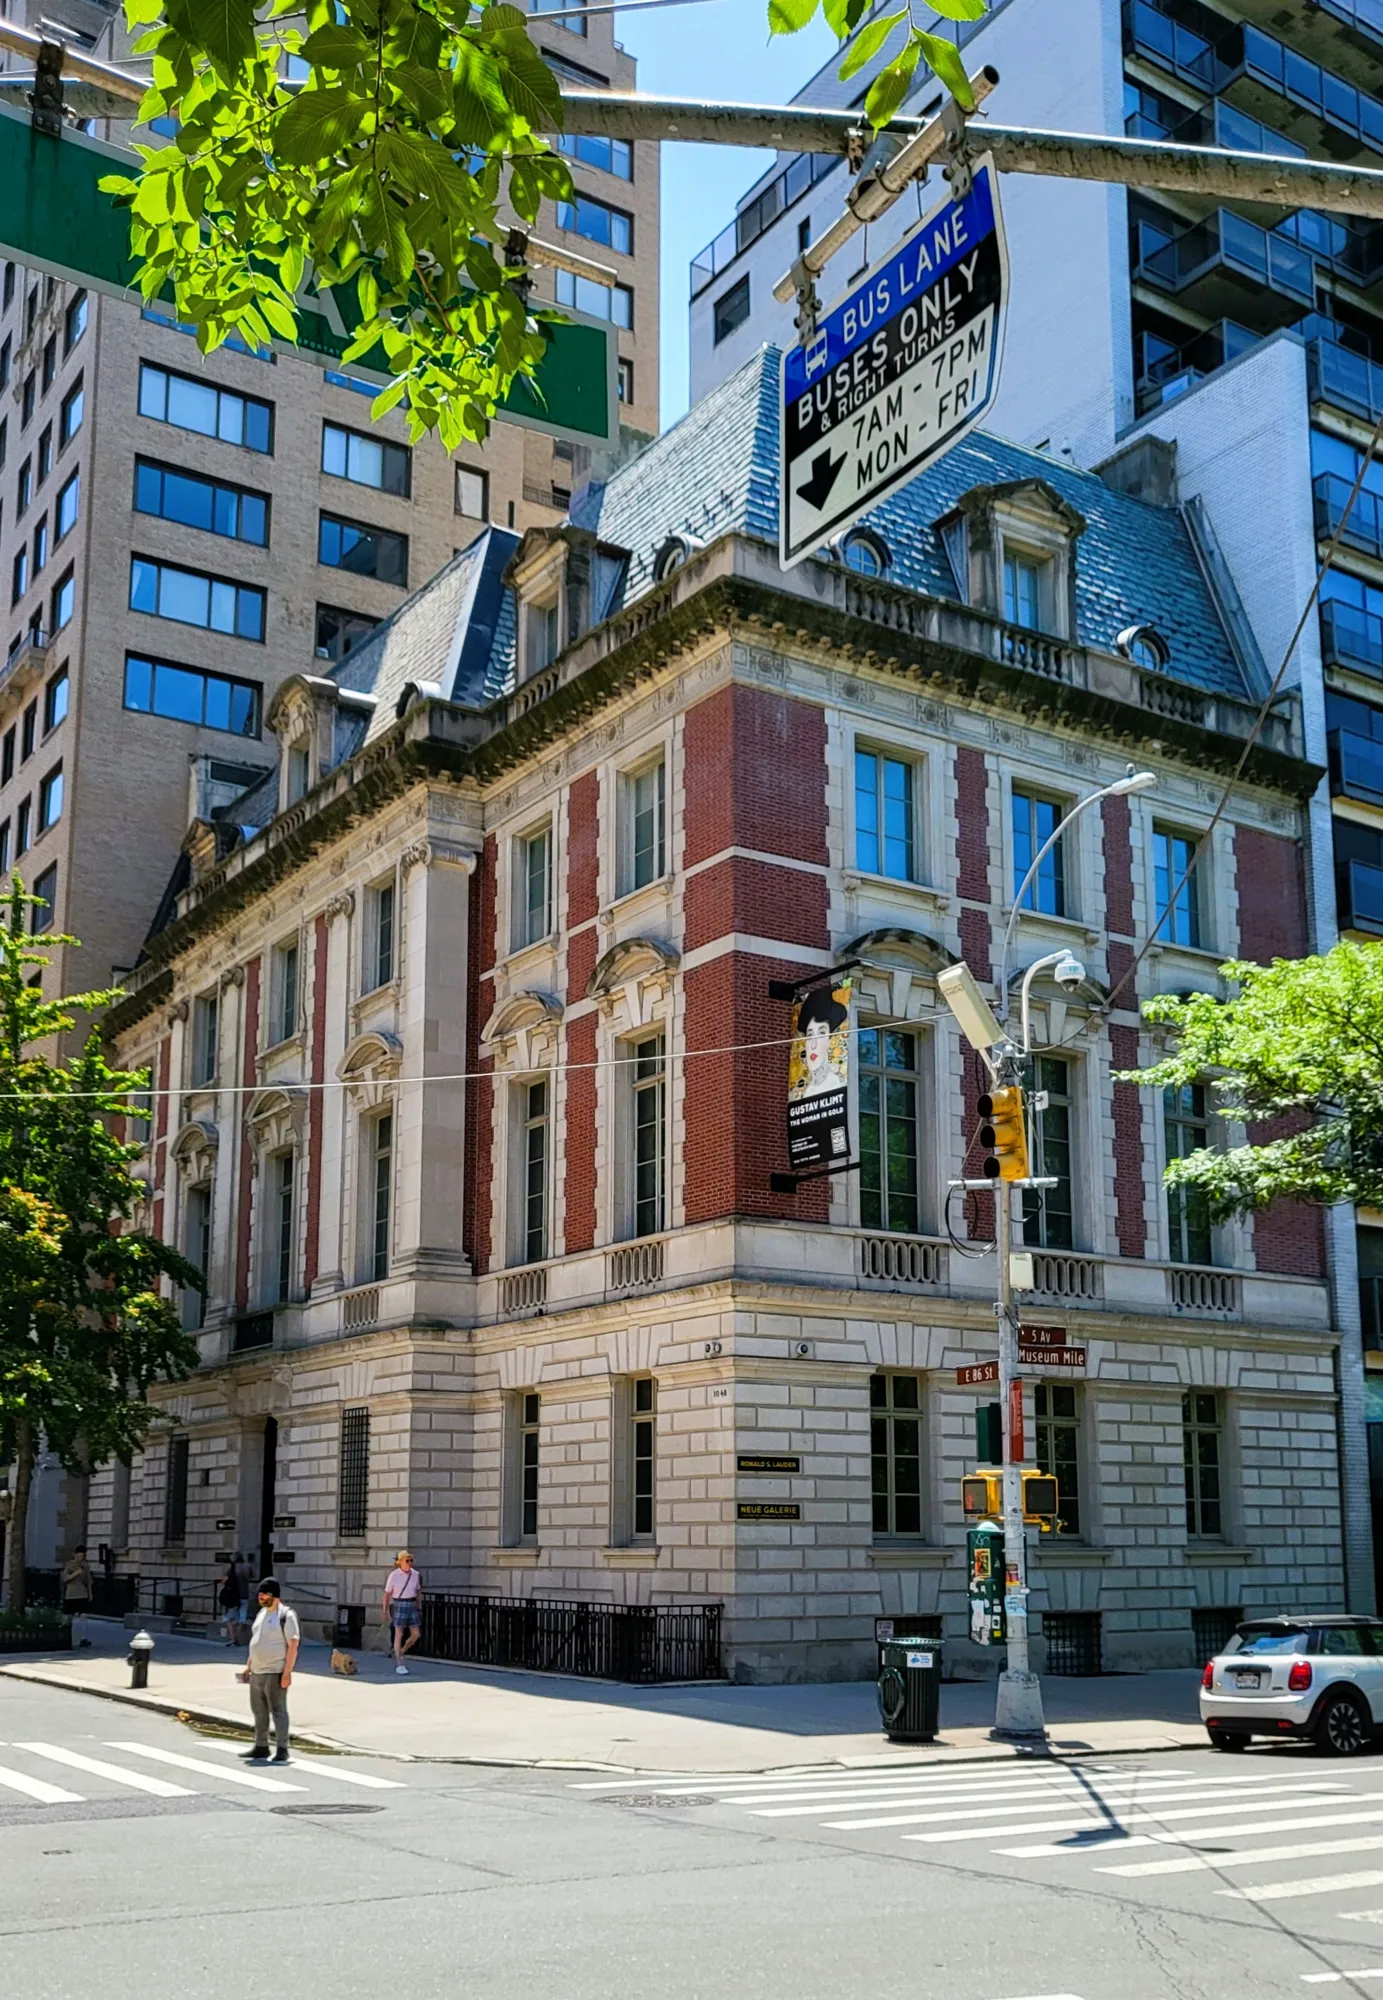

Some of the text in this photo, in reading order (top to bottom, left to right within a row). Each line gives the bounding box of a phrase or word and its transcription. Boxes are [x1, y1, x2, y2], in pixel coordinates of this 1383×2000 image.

[843, 205, 968, 344] BUS LANE
[799, 250, 979, 430] BUSES ONLY
[821, 312, 955, 432] & RIGHT TURNS
[853, 385, 902, 449] 7AM
[932, 318, 986, 389] 7PM
[857, 424, 908, 490] MON
[938, 369, 976, 429] FRI
[790, 1094, 844, 1116] GUSTAV KLIMT
[790, 1119, 800, 1127] THE
[801, 1113, 820, 1124] WOMAN
[828, 1107, 844, 1116] GOLD
[1032, 1330, 1051, 1343] 5 Av
[1019, 1349, 1084, 1365] Museum Mile
[965, 1366, 993, 1382] E 86 St
[740, 1460, 765, 1468] RONALD
[763, 1506, 797, 1514] GALERIE
